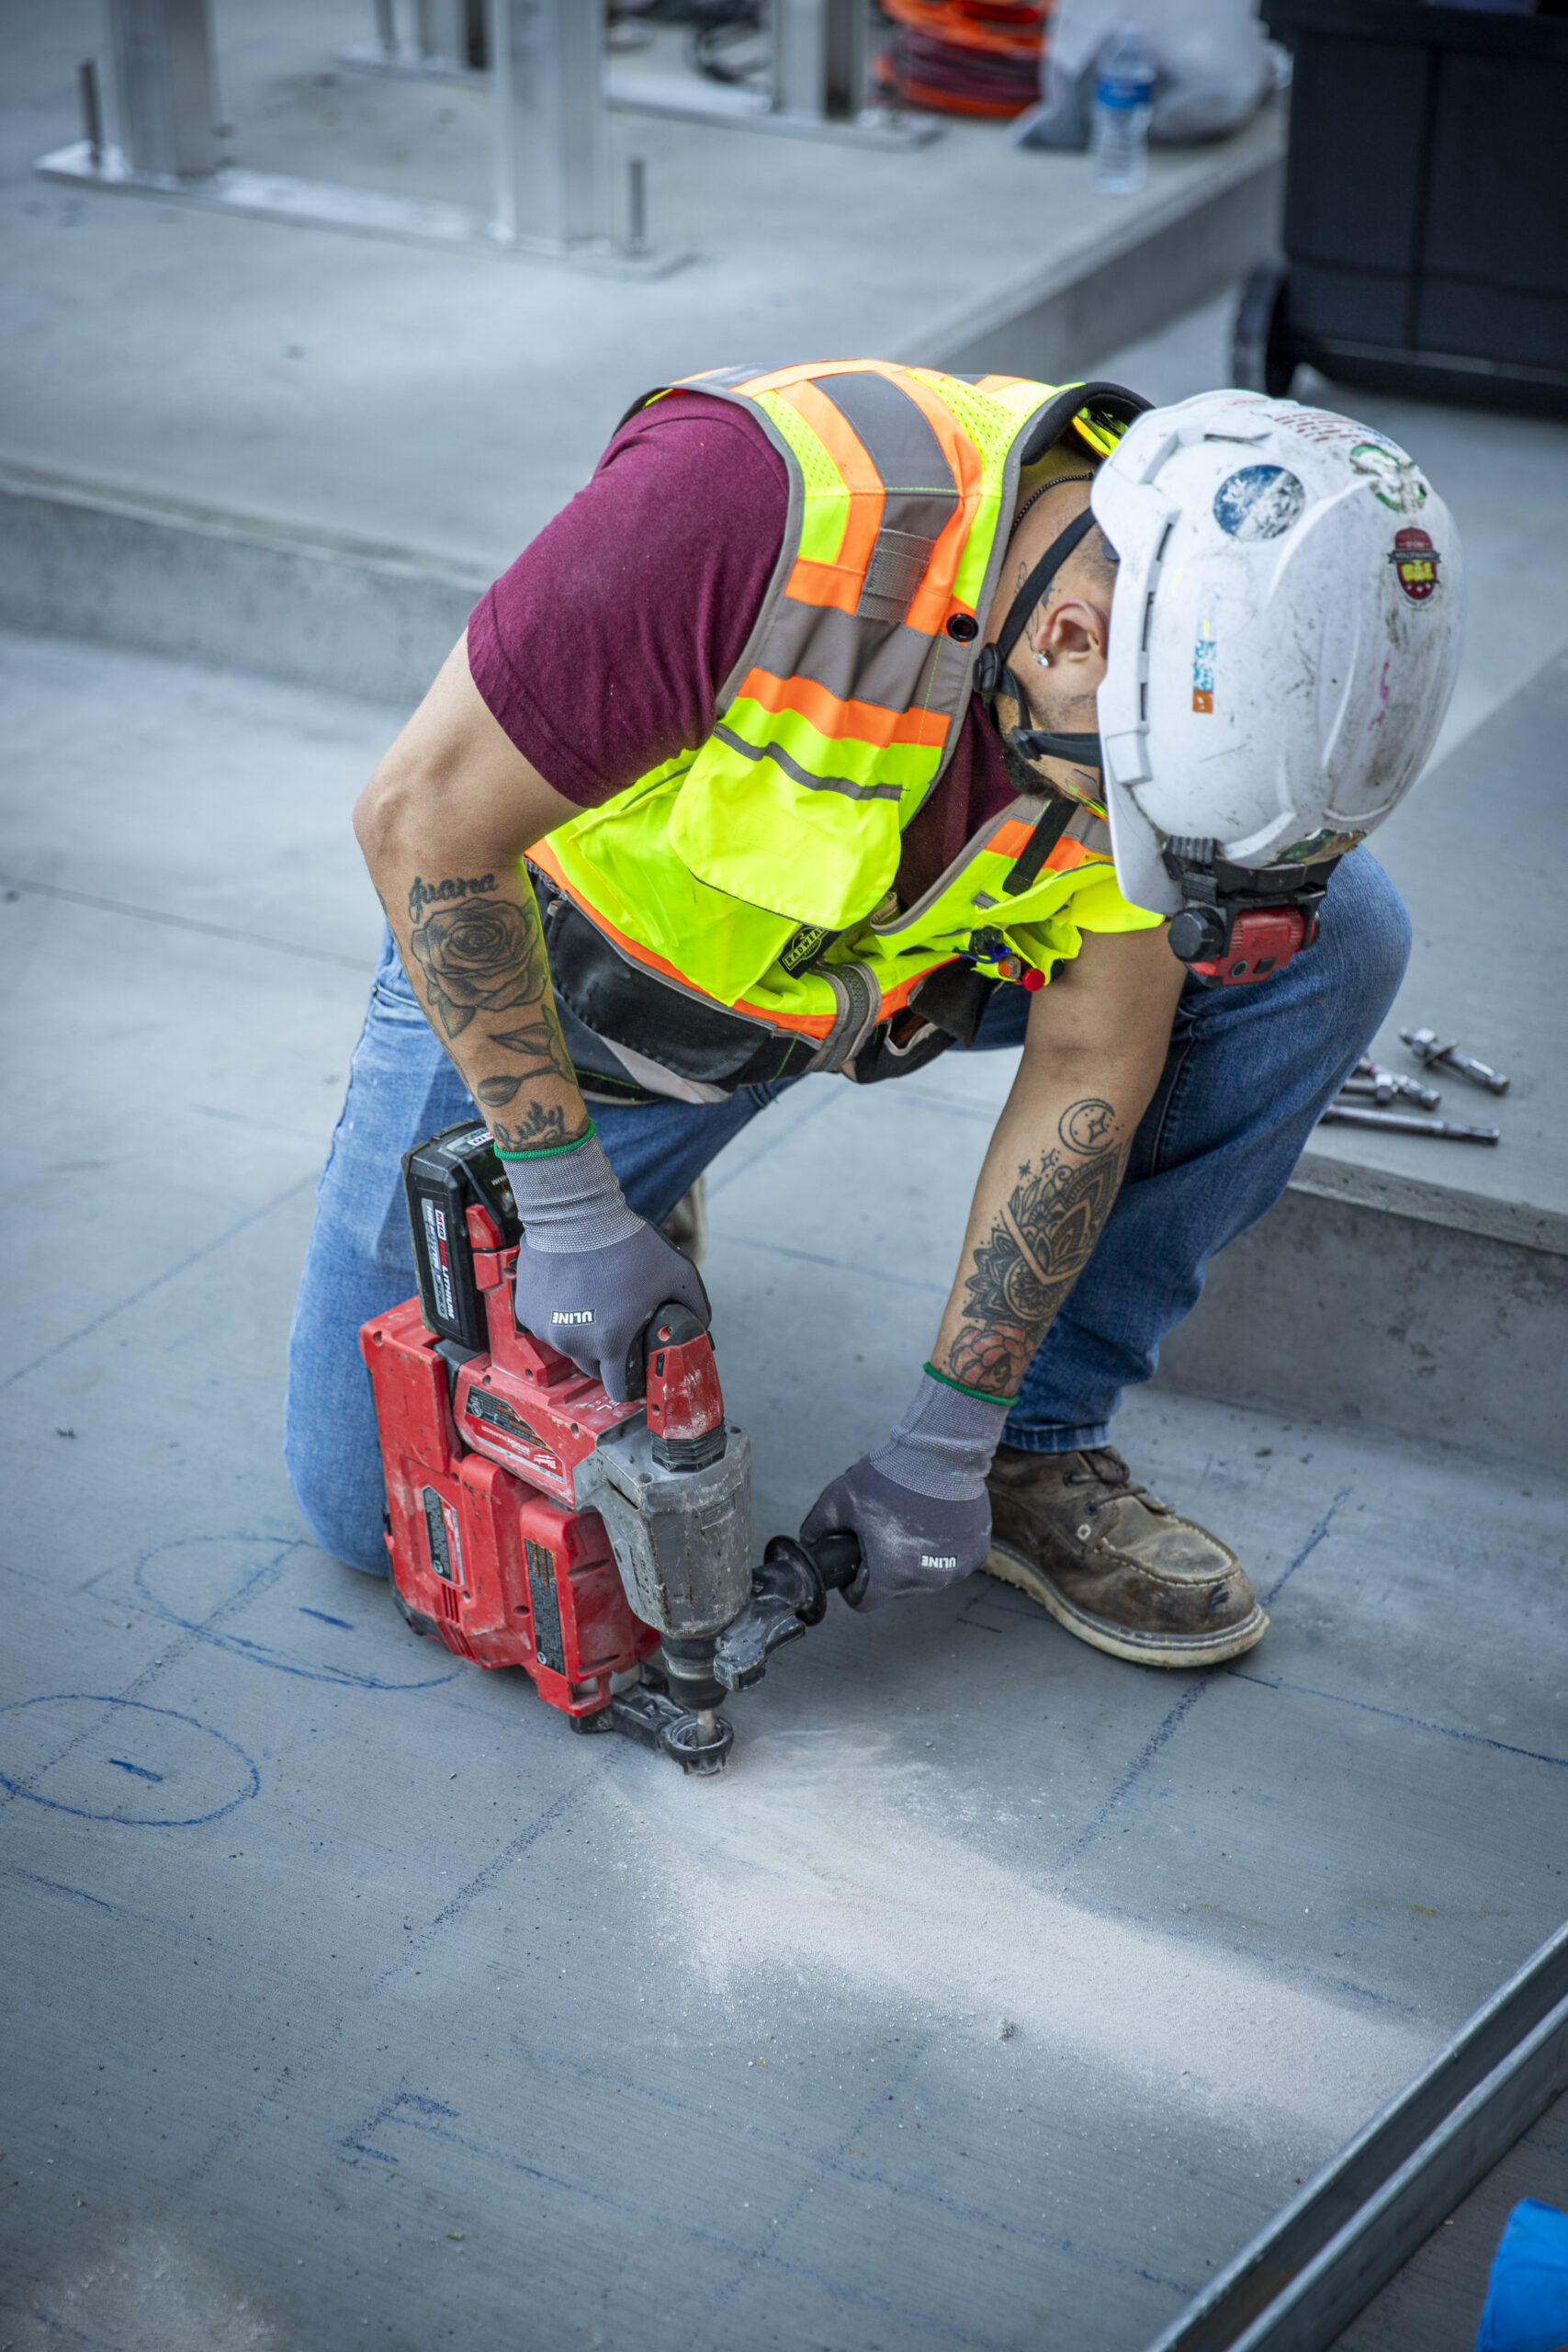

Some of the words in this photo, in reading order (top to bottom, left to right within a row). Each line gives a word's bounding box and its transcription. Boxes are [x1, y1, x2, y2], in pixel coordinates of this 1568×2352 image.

[785, 927, 824, 966] RADWEA
[436, 1211, 445, 1238] M18
[439, 1238, 456, 1319] REDLITHIUM
[551, 1310, 592, 1324] ULINE
[920, 1555, 956, 1569] ULINE
